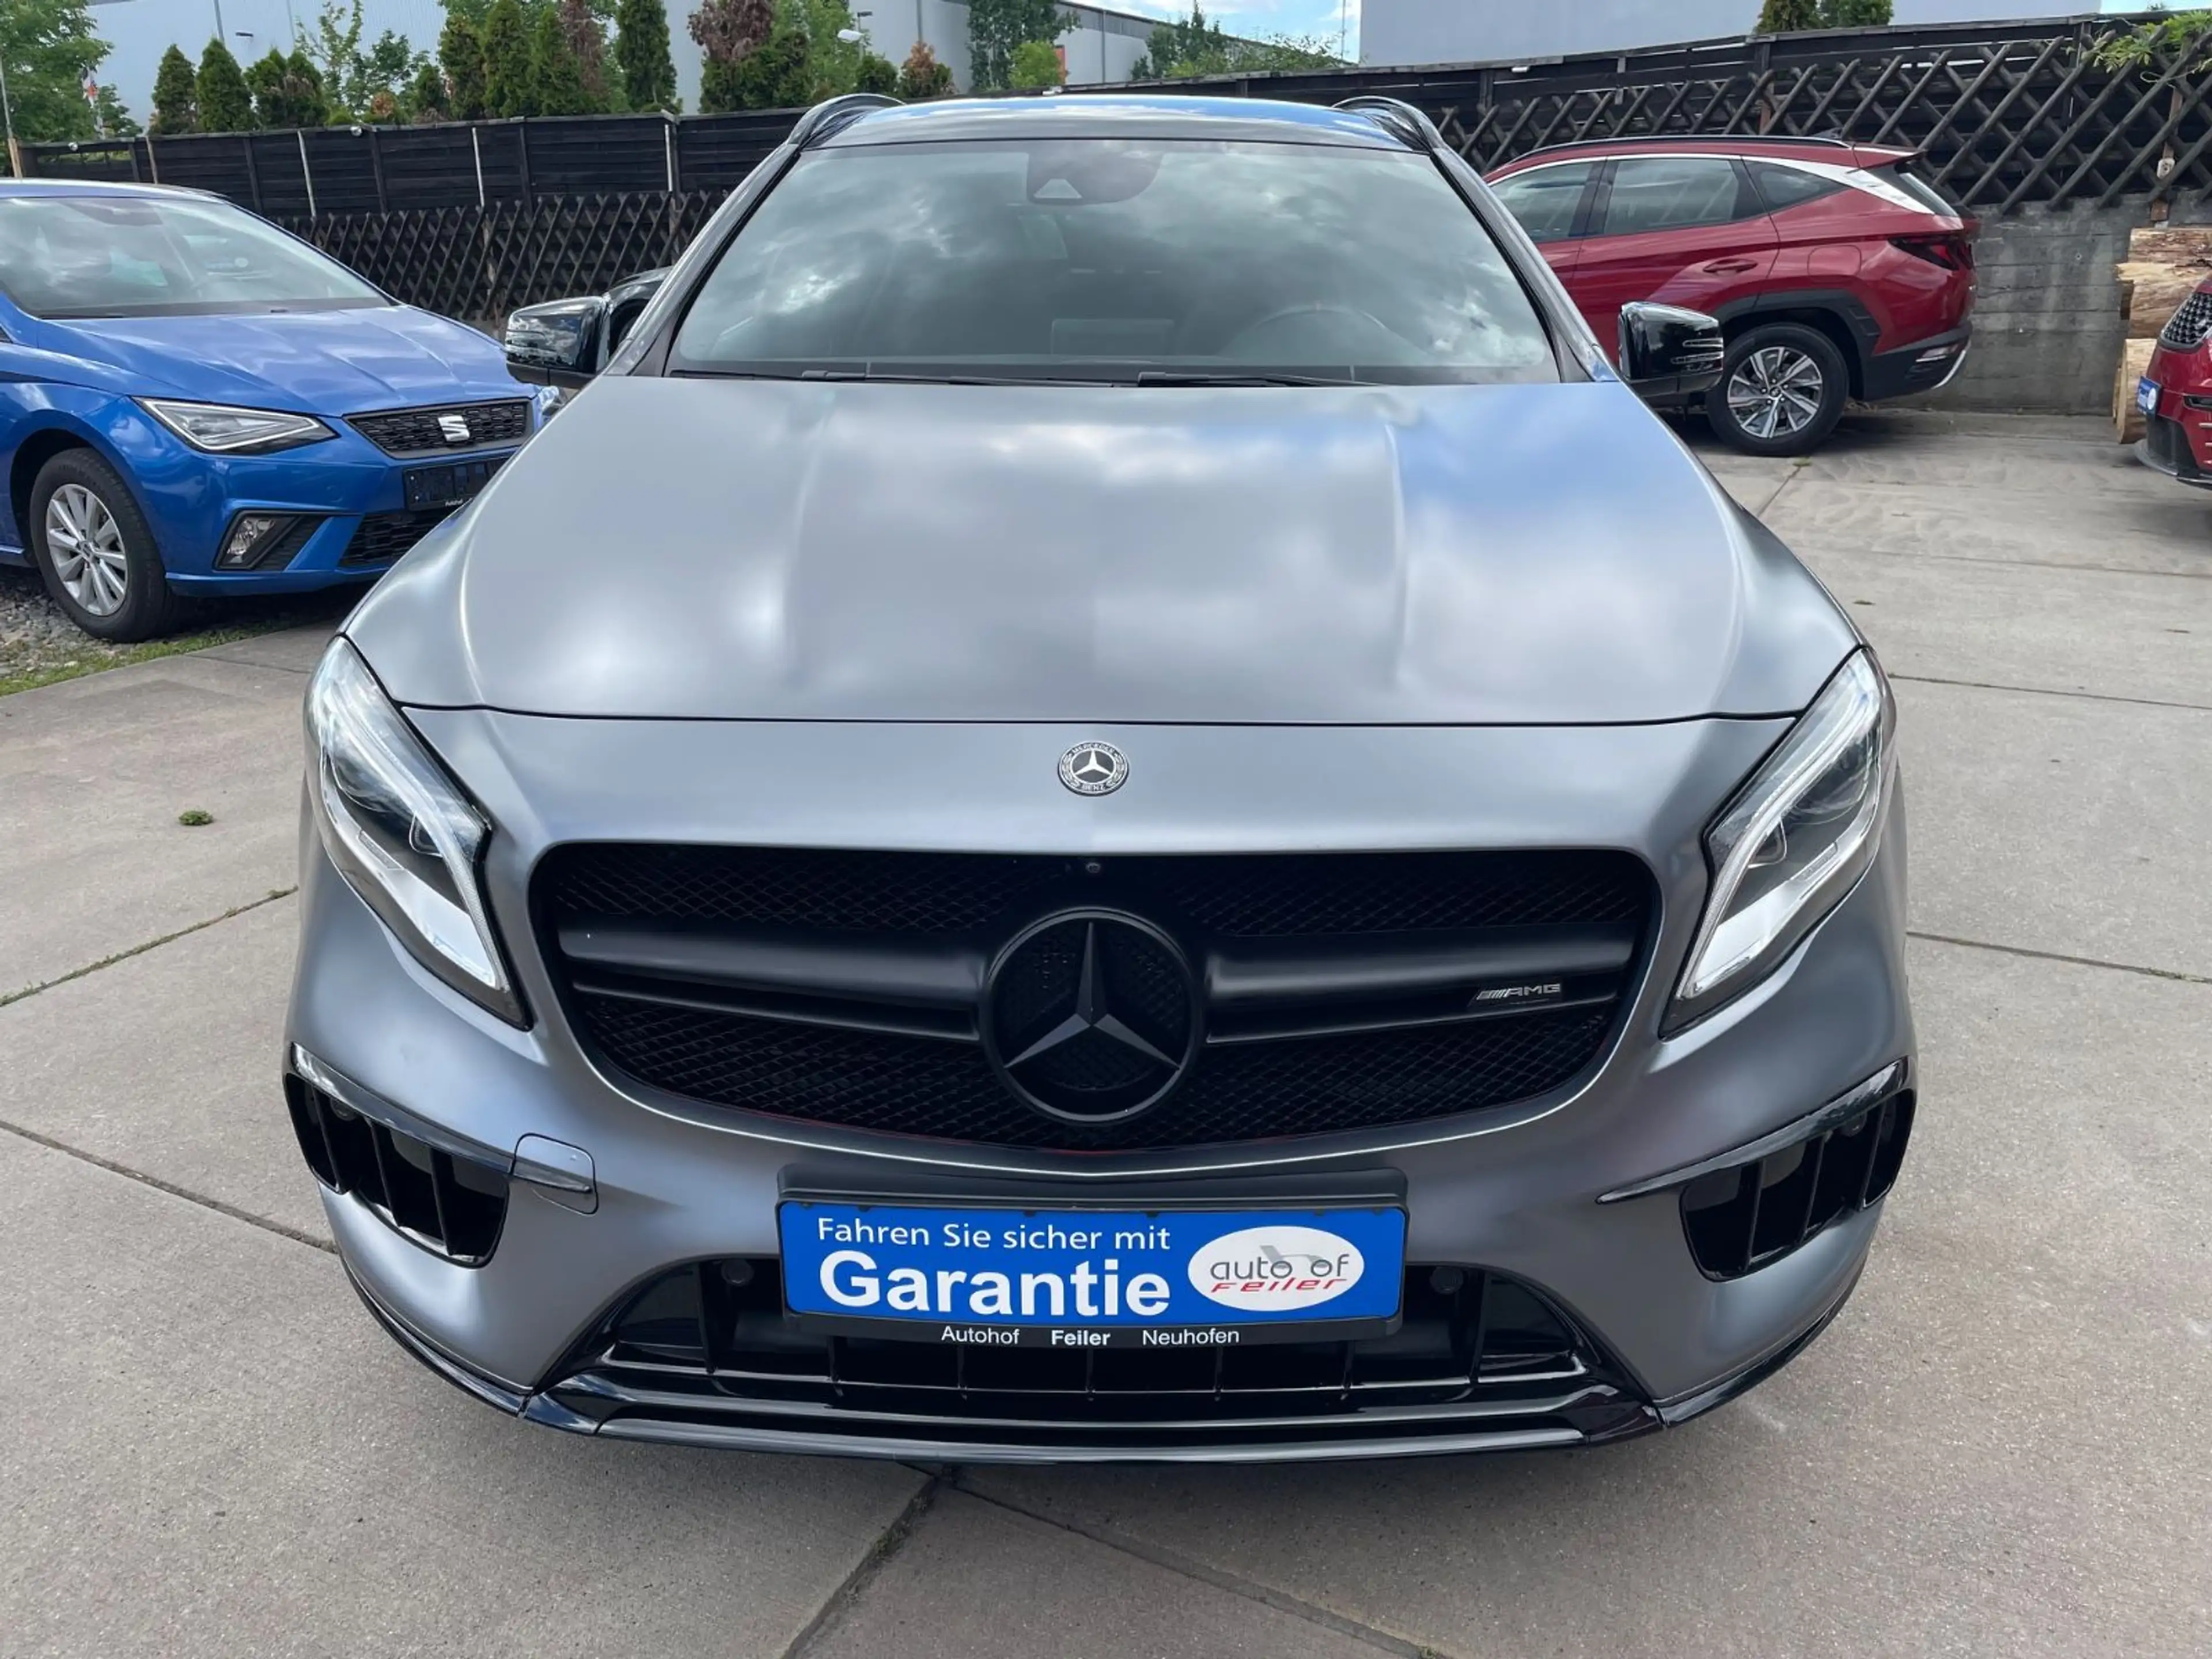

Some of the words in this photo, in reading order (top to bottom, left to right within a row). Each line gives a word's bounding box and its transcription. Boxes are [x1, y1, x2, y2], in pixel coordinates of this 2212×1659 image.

[1503, 983, 1560, 998] AMG
[818, 1217, 929, 1245] Fahren
[944, 1223, 991, 1248] Sie
[1003, 1224, 1102, 1249] sicher
[1115, 1225, 1171, 1249] mit
[820, 1249, 1171, 1316] Garantie
[1211, 1277, 1347, 1293] Feiler
[941, 1325, 1020, 1344] Autohof
[1051, 1330, 1111, 1346] Feiler
[1142, 1328, 1239, 1346] Neuhofen
